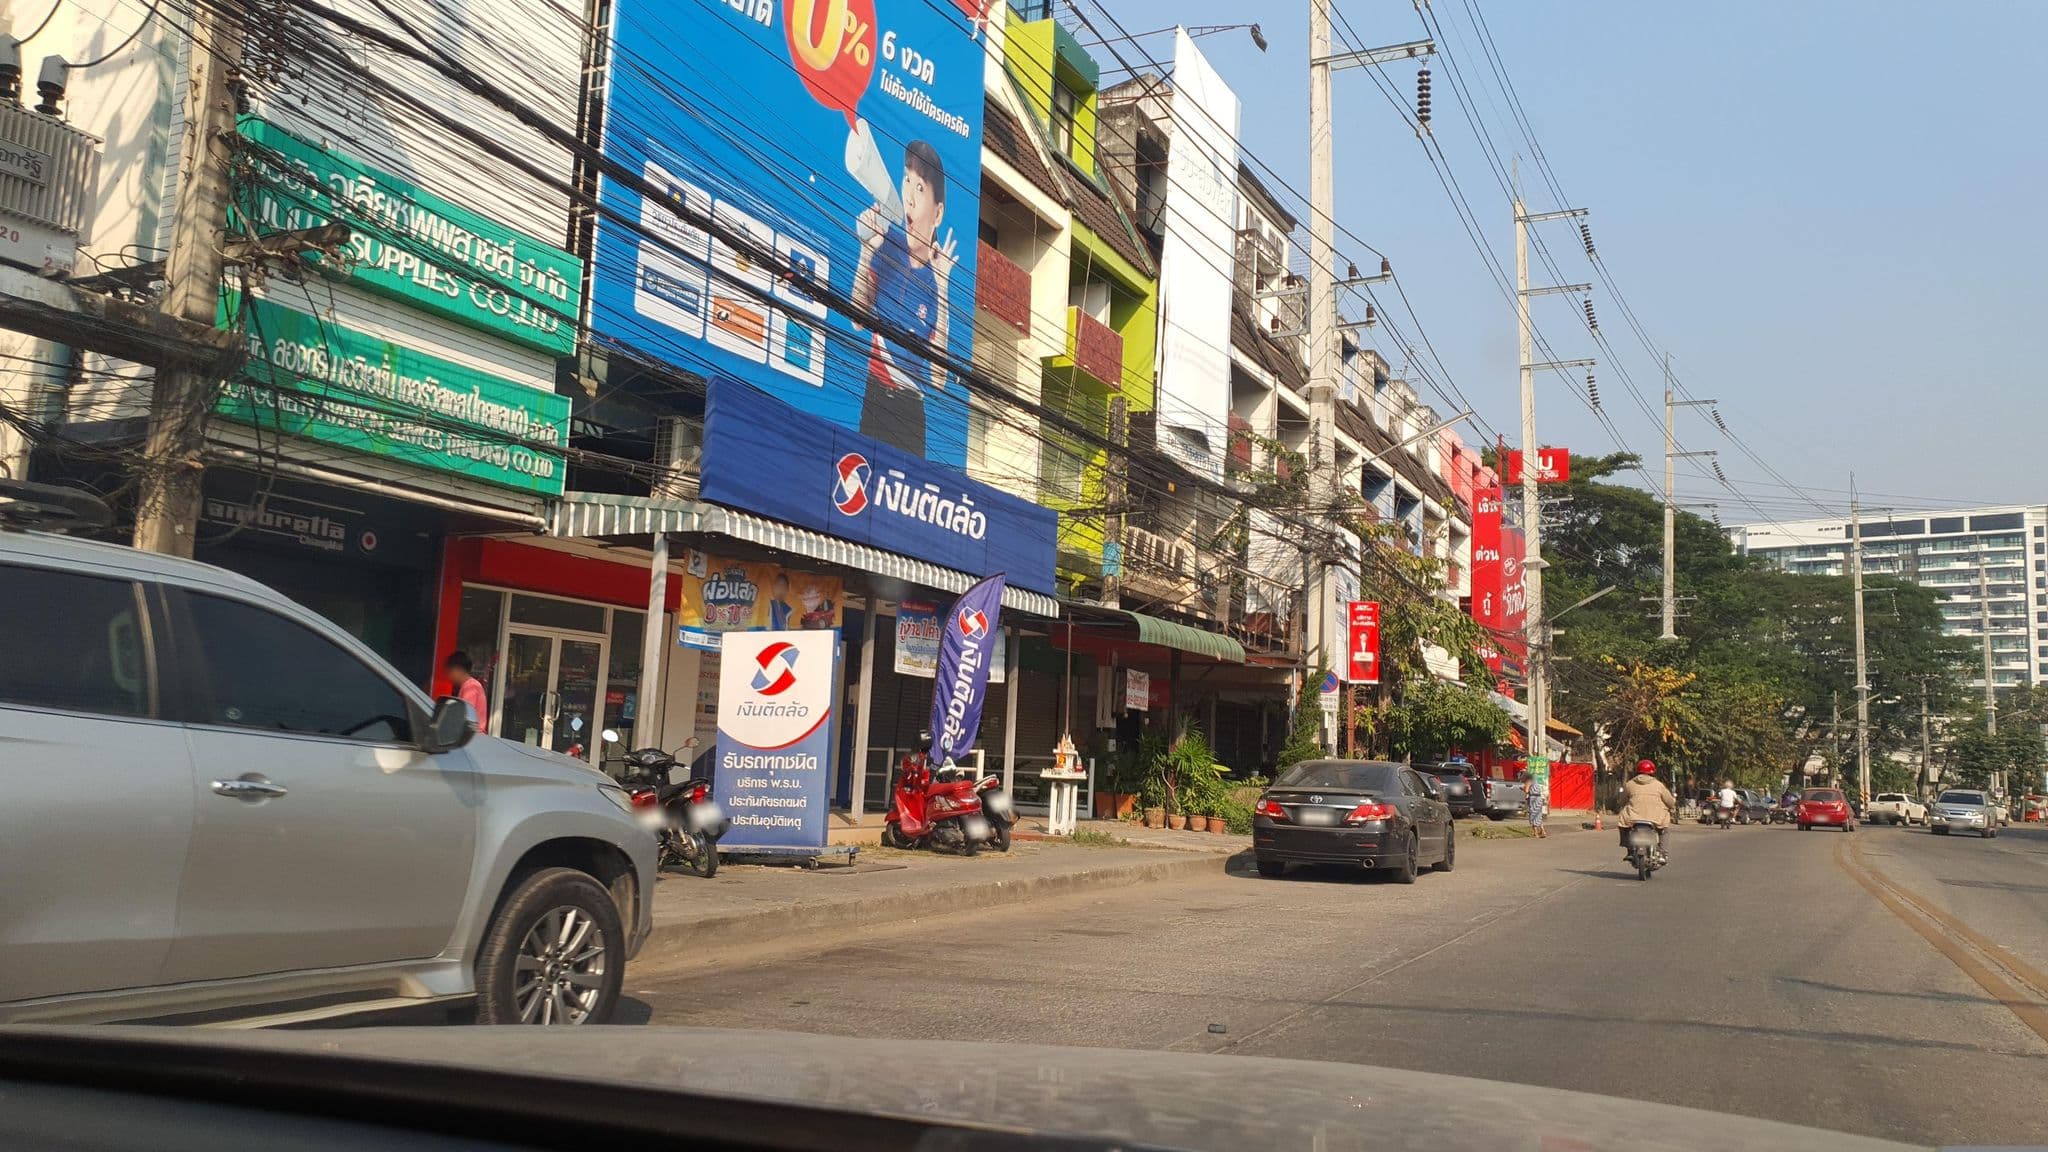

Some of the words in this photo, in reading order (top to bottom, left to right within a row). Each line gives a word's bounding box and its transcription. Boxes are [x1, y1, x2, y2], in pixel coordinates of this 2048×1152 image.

[881, 31, 897, 61] 6
[901, 46, 935, 85] งวด
[880, 68, 970, 139] ไม่ต้องใช้บัตรเครดิต
[348, 231, 460, 299] SUPPLIES
[519, 258, 568, 302] จำกัด
[873, 468, 987, 541] เงินติดล้อ
[736, 701, 809, 718] เงินติดล้อ
[939, 639, 984, 753] เงินติดล้อ
[722, 752, 818, 777] รับรถทุกชนิด
[737, 776, 768, 789] บริการ
[770, 779, 802, 789] พ.ร.บ.
[729, 795, 807, 808] ประกันภัยรถยนต์
[732, 814, 802, 830] ประกันอุบัติเหตุ
